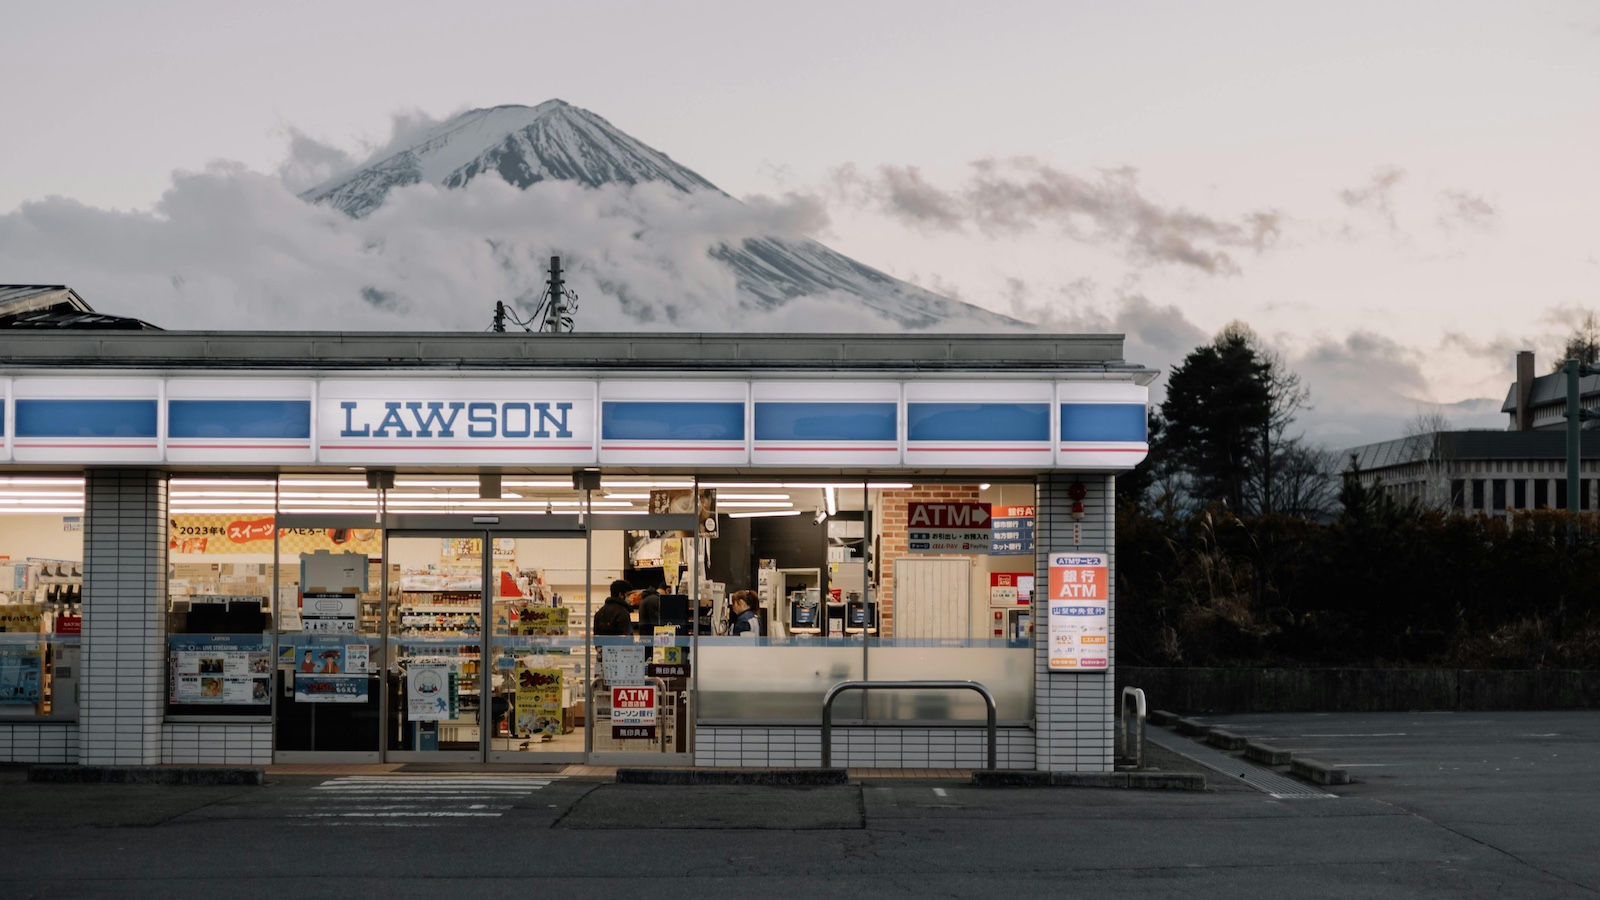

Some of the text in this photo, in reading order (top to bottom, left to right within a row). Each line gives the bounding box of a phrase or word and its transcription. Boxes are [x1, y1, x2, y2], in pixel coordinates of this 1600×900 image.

[340, 401, 573, 438] LAWSON
[910, 504, 971, 526] ATM
[180, 526, 226, 535] 2023年も
[1063, 569, 1095, 583] 銀行
[1060, 584, 1096, 597] ATM
[655, 667, 685, 675] 無印良品
[617, 689, 649, 701] ATM
[619, 728, 649, 737] 無印良品
